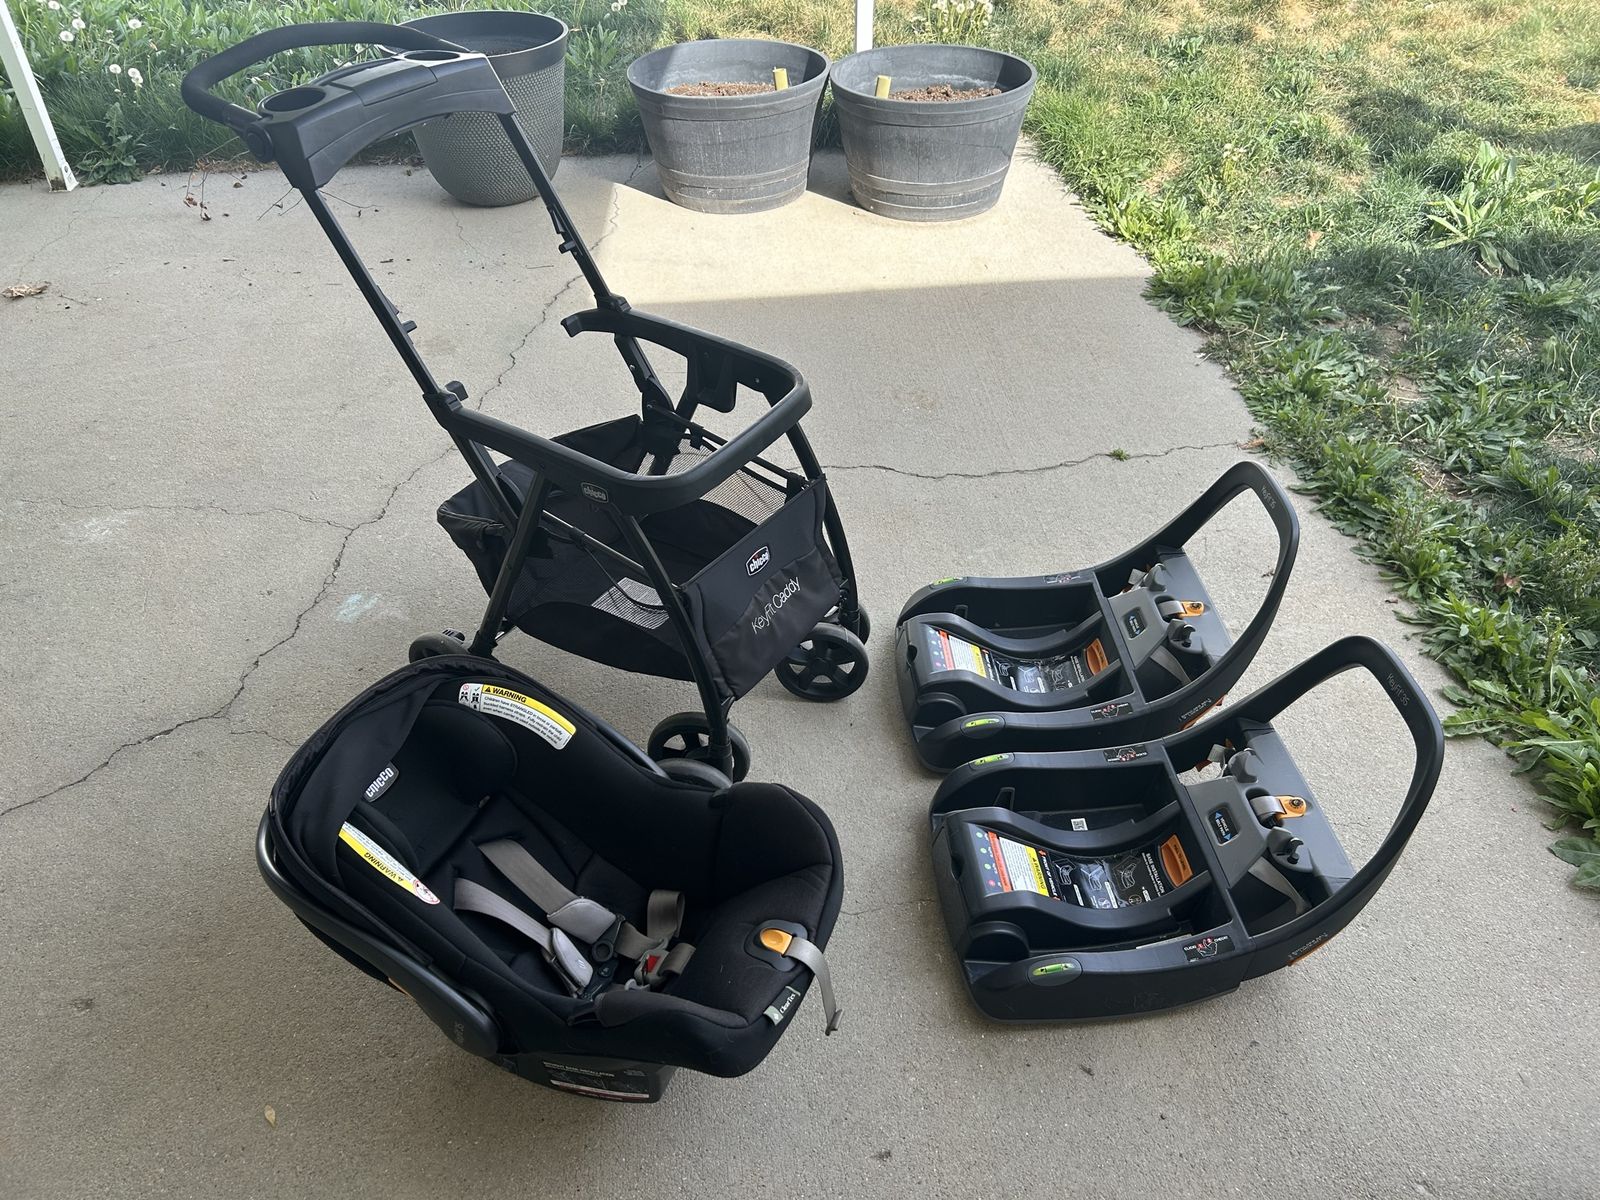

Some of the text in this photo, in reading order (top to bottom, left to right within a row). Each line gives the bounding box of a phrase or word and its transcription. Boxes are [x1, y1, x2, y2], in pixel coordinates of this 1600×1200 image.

[749, 552, 769, 572] chicco
[751, 576, 800, 634] KeyFit Caddy
[492, 687, 527, 703] WARNING
[365, 767, 394, 797] chicco
[364, 852, 397, 879] WARNING
